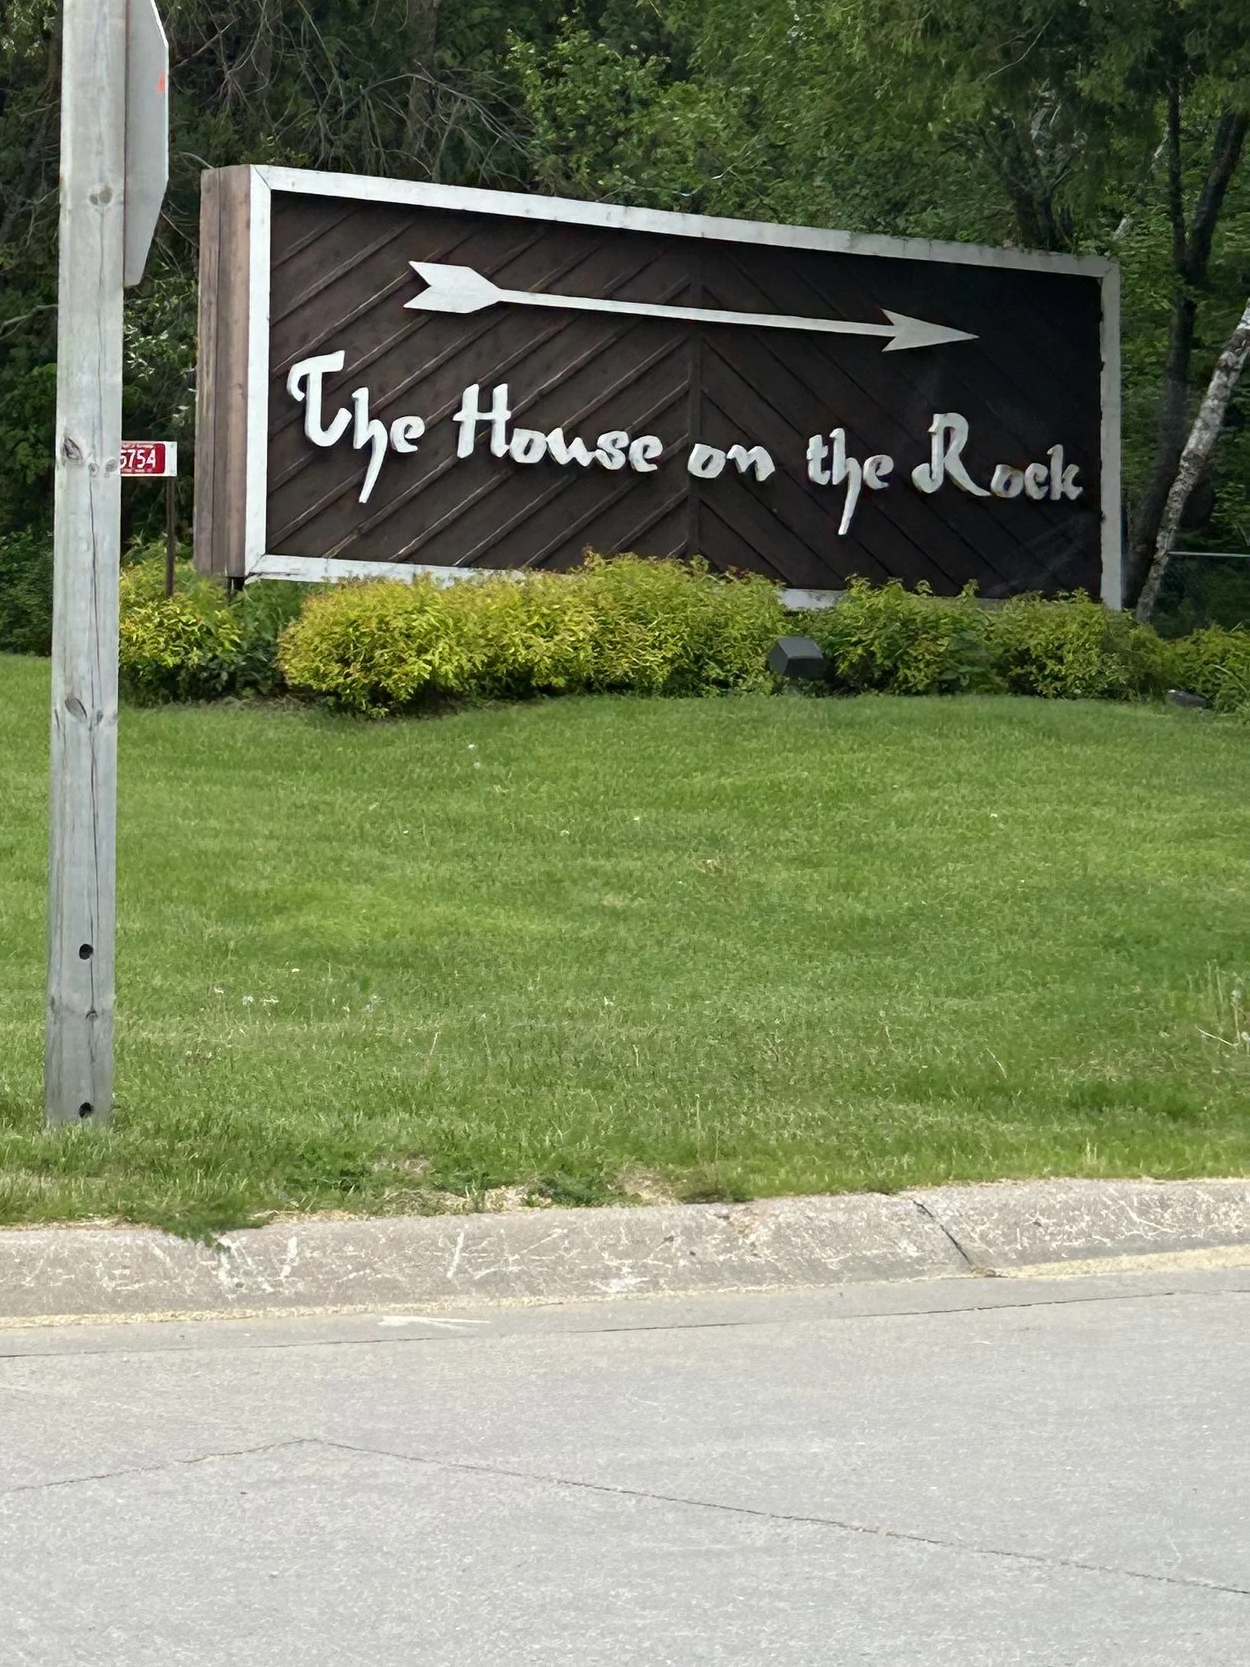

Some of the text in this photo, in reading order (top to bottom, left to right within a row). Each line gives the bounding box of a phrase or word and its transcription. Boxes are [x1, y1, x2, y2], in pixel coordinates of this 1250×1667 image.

[287, 350, 1083, 536] The House on the Rock
